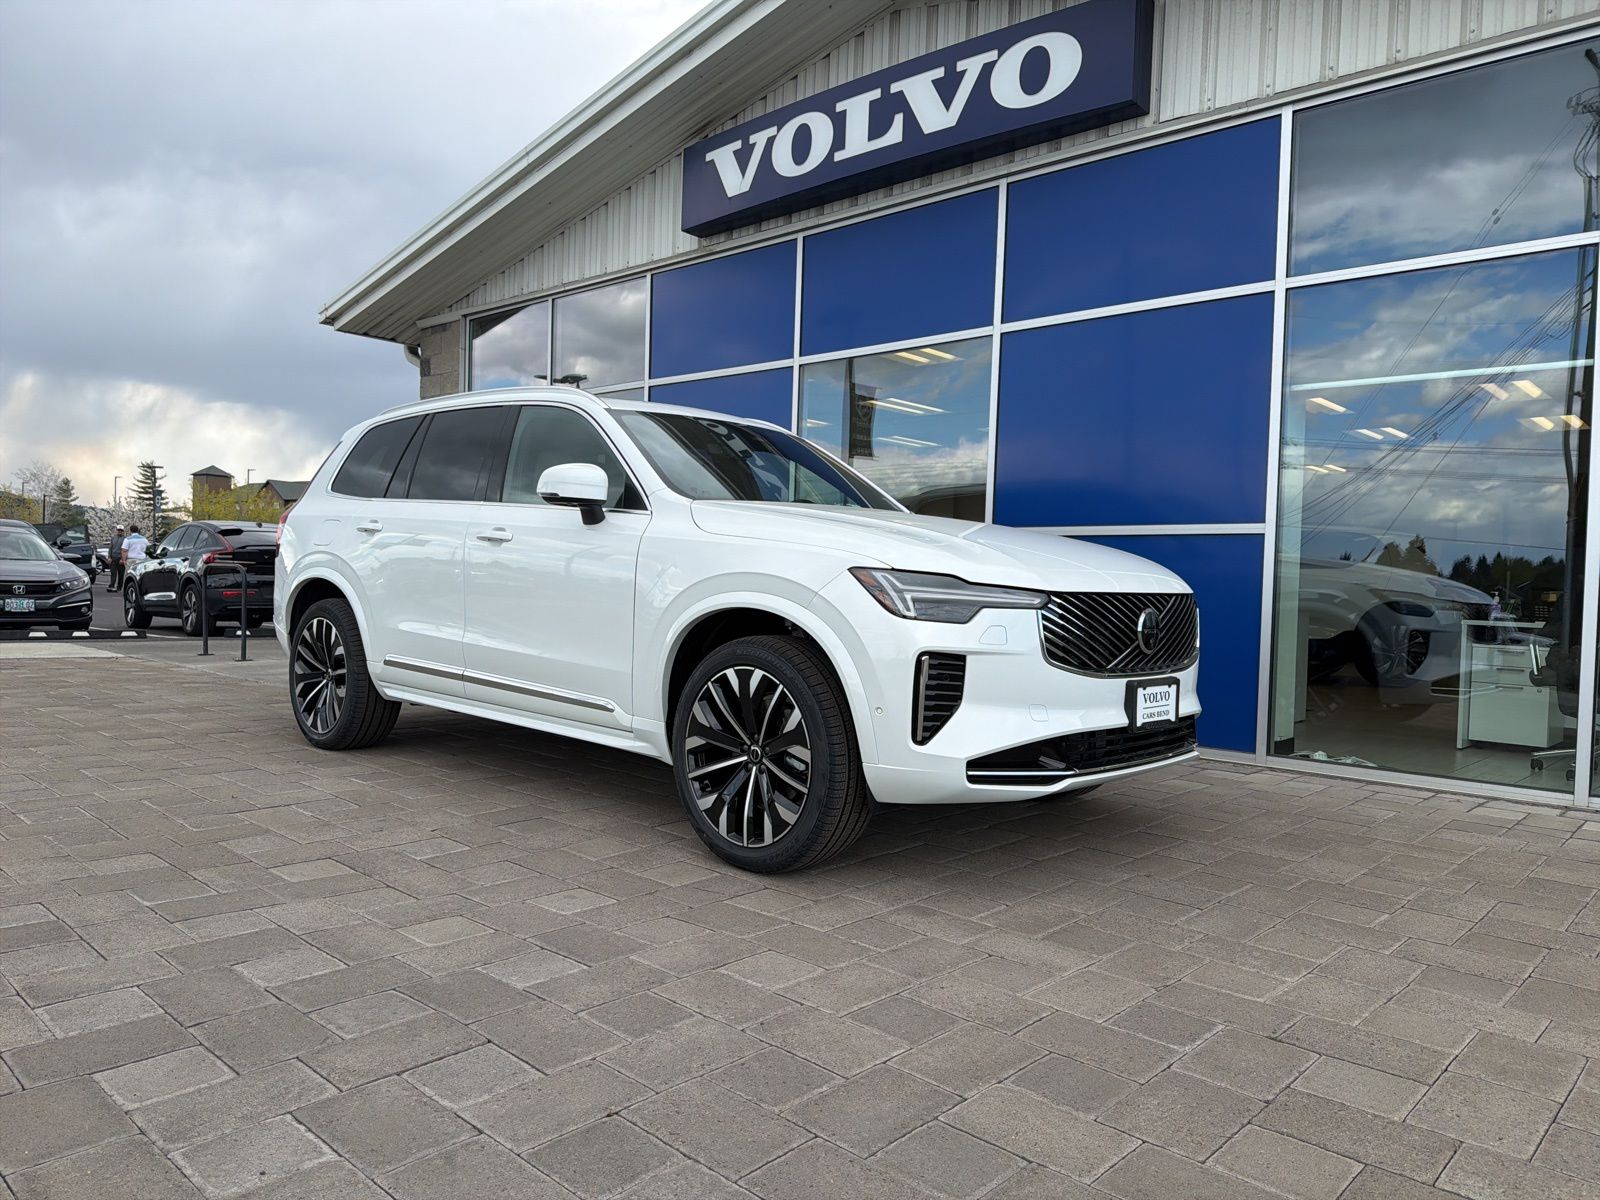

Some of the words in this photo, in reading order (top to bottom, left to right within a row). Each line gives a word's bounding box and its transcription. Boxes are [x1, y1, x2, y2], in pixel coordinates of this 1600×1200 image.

[705, 31, 1083, 198] VOLVO
[1142, 690, 1171, 704] VOLVO
[1142, 711, 1156, 720] CARS
[1156, 709, 1170, 718] BEND
